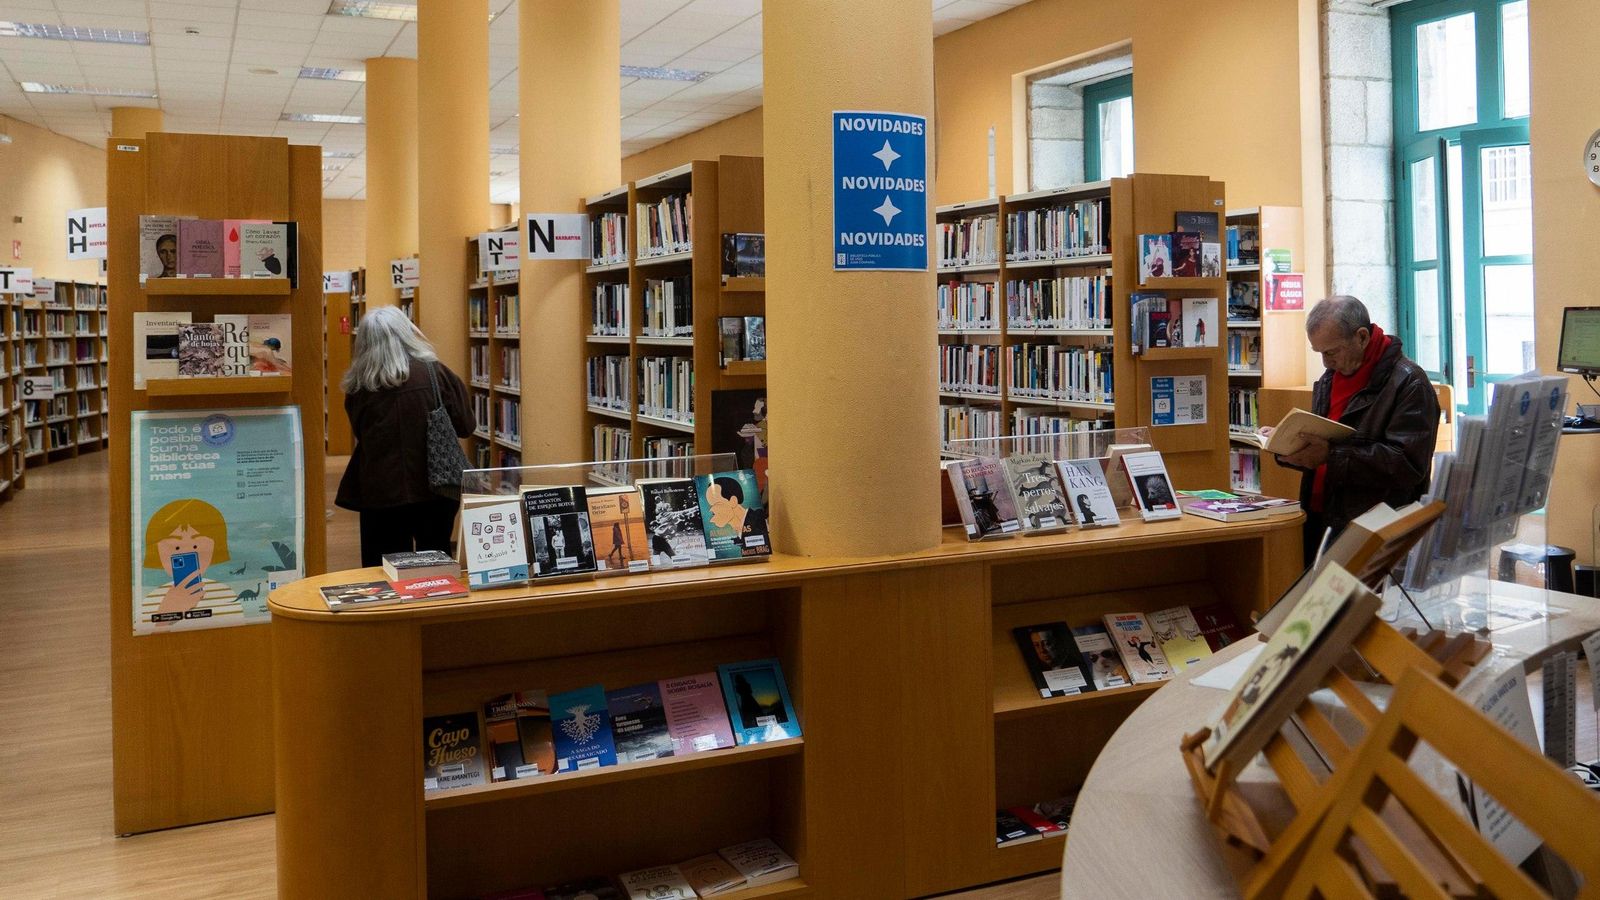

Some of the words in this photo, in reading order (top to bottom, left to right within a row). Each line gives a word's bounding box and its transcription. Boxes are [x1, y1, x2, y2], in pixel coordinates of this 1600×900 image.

[840, 118, 923, 136] NOVIDADES
[1591, 153, 1597, 161] 9
[1593, 165, 1599, 173] 8
[842, 176, 924, 193] NOVIDADES
[68, 216, 87, 234] N
[529, 219, 555, 253] N
[840, 232, 924, 247] NOVIDADES
[69, 235, 87, 253] H
[488, 237, 503, 250] N
[490, 252, 503, 265] T
[391, 264, 404, 274] N
[0, 271, 14, 289] T
[393, 274, 404, 284] R
[185, 333, 215, 341] Manto
[224, 322, 249, 343] Ré
[201, 340, 221, 348] hojas
[23, 379, 34, 396] 8
[150, 425, 187, 435] Todo
[192, 423, 202, 433] é
[150, 434, 203, 444] posible
[150, 443, 198, 453] cunha
[150, 452, 220, 462] biblioteca
[150, 462, 177, 471] nas
[182, 461, 216, 470] túas
[1065, 465, 1092, 477] HAN
[150, 472, 192, 481] mans
[1022, 472, 1046, 484] Tres
[1070, 475, 1103, 489] KANG
[1022, 486, 1056, 499] perros
[1024, 501, 1064, 514] salvajes
[429, 727, 470, 748] Cayo
[428, 745, 476, 767] Hueso
